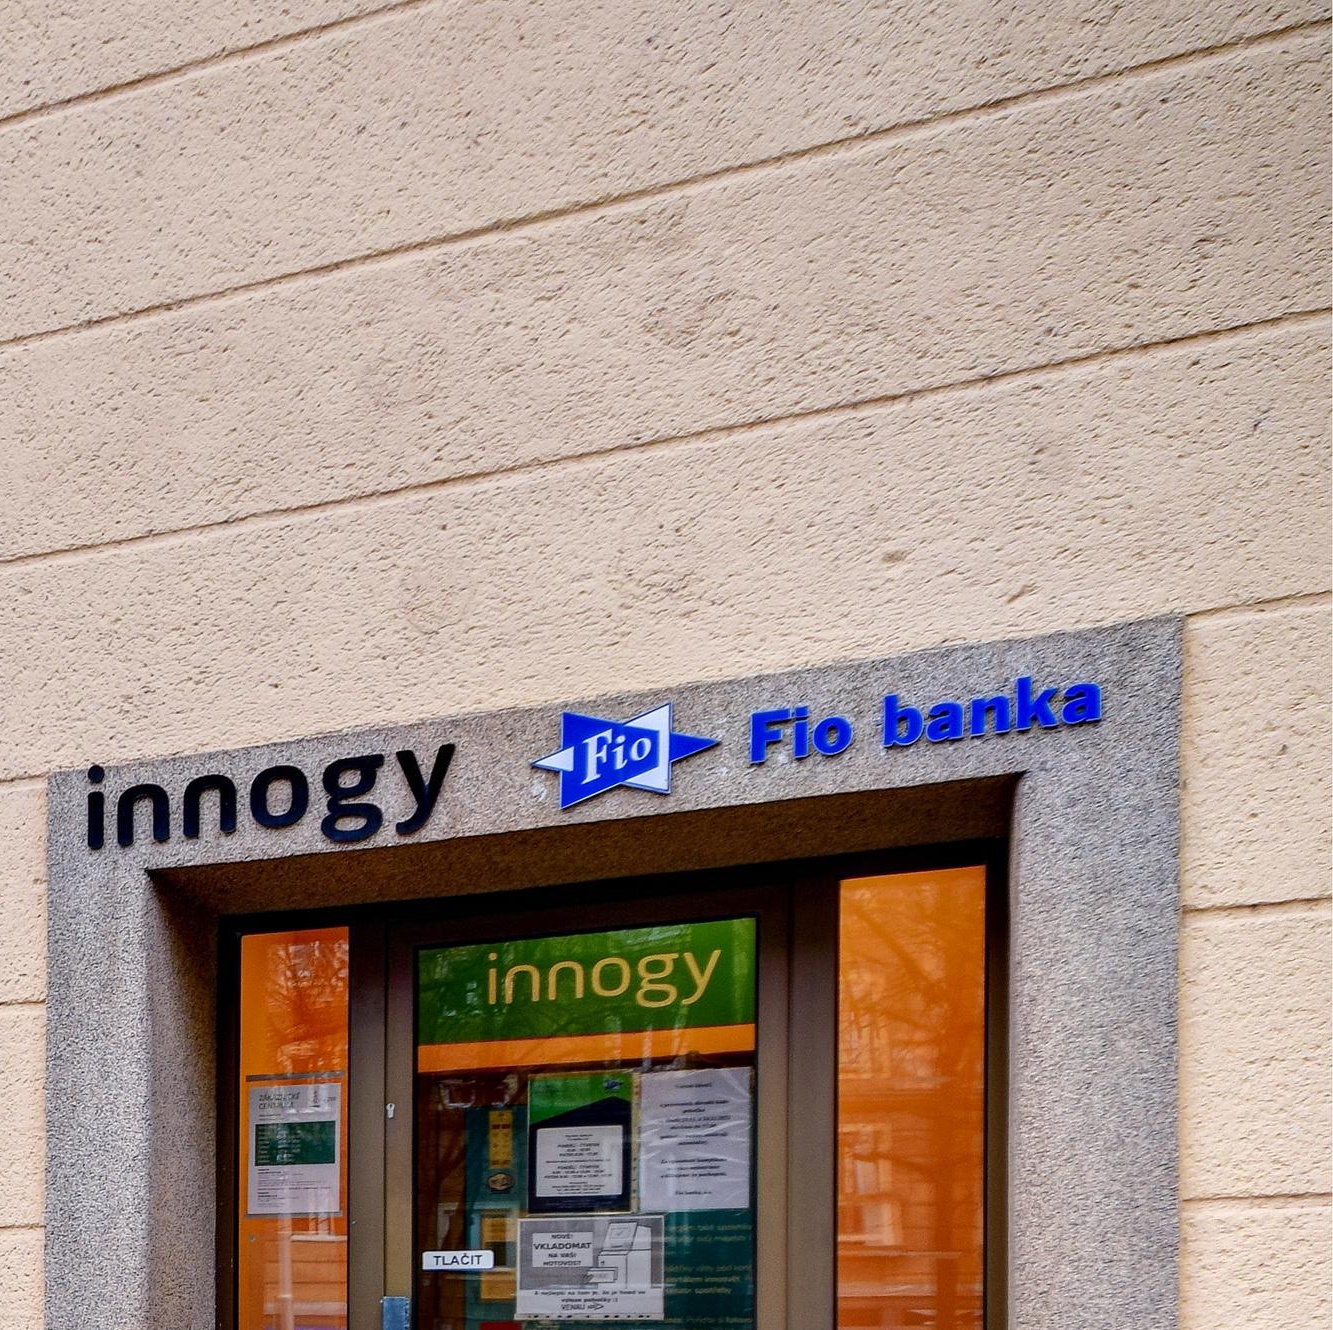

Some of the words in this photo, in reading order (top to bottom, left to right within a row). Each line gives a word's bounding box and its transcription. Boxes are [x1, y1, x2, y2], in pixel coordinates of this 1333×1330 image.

[749, 705, 854, 765] Fio
[883, 676, 1102, 748] banka
[580, 728, 652, 785] Fio
[87, 743, 456, 850] innogy
[488, 949, 722, 1008] innogy
[433, 1253, 484, 1267] TLAČIT
[533, 1242, 592, 1250] VKLADOMAT
